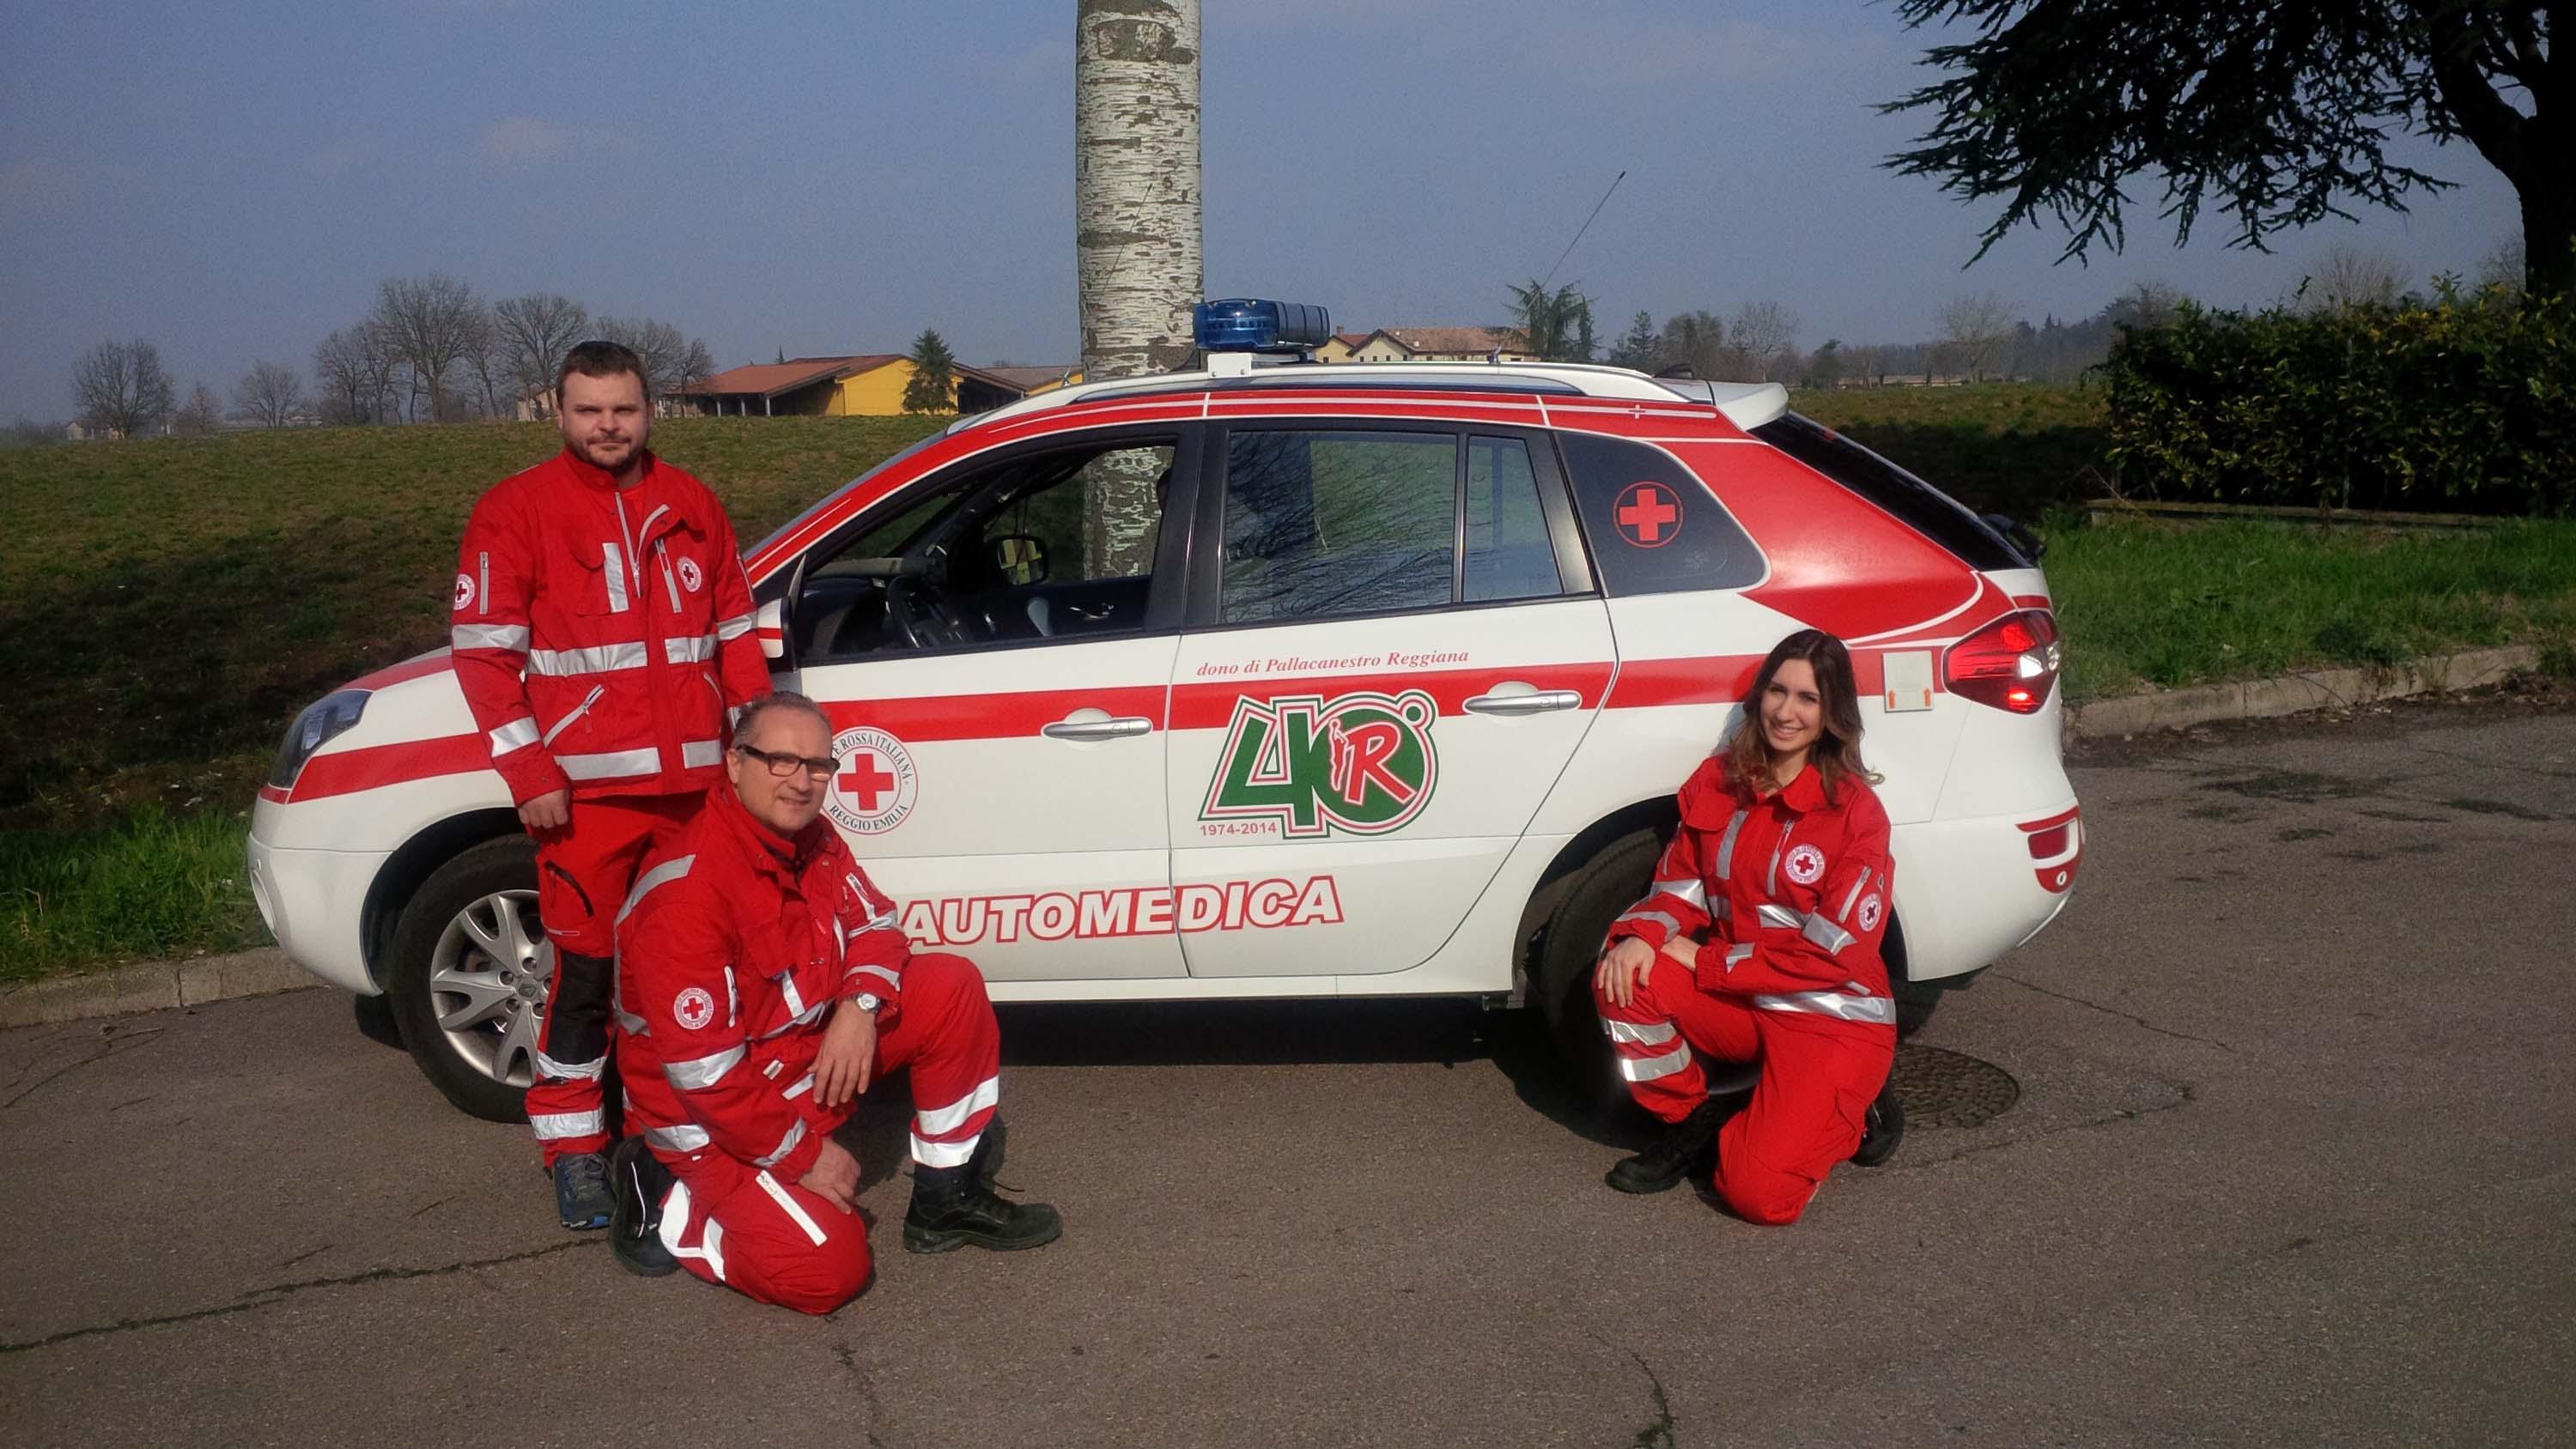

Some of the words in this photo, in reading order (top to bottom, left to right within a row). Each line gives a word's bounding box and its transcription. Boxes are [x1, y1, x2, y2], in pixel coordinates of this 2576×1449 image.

[1197, 663, 1239, 676] dono
[1244, 659, 1261, 673] di
[1266, 655, 1381, 672] Pallacanestro
[1388, 650, 1469, 667] Reggiana
[840, 733, 873, 749] ROSSA
[876, 735, 913, 779] ITALIANA
[829, 805, 871, 831] REGGIO
[874, 805, 908, 830] EMILIA
[1200, 822, 1277, 836] 1974-2014
[898, 875, 1344, 945] AUTOMEDICA
